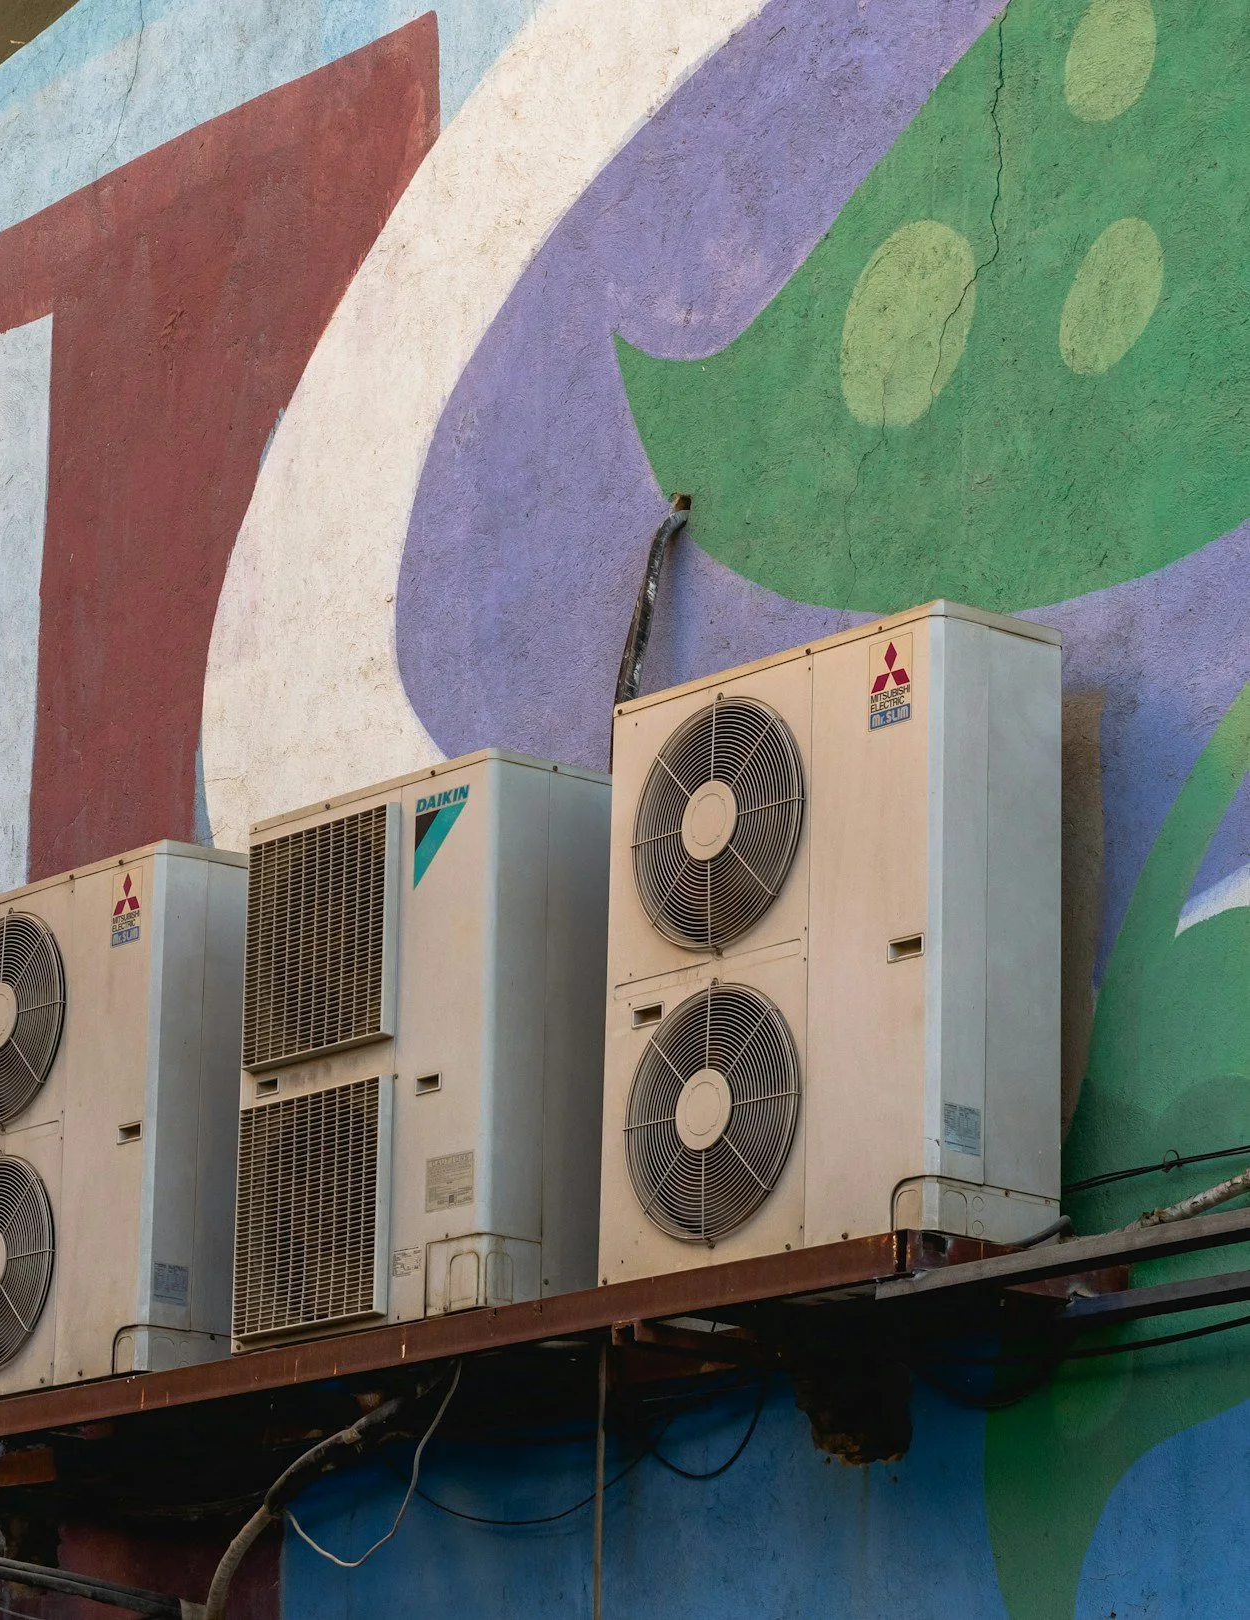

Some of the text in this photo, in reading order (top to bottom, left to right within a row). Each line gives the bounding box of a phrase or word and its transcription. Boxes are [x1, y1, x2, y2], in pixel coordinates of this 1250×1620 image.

[871, 684, 910, 704] MITSUBISHI
[871, 696, 905, 713] ELECTRIC
[416, 785, 470, 813] DAIKIN
[112, 919, 136, 933] ELECTRIC
[113, 910, 140, 925] MITSUBISHI
